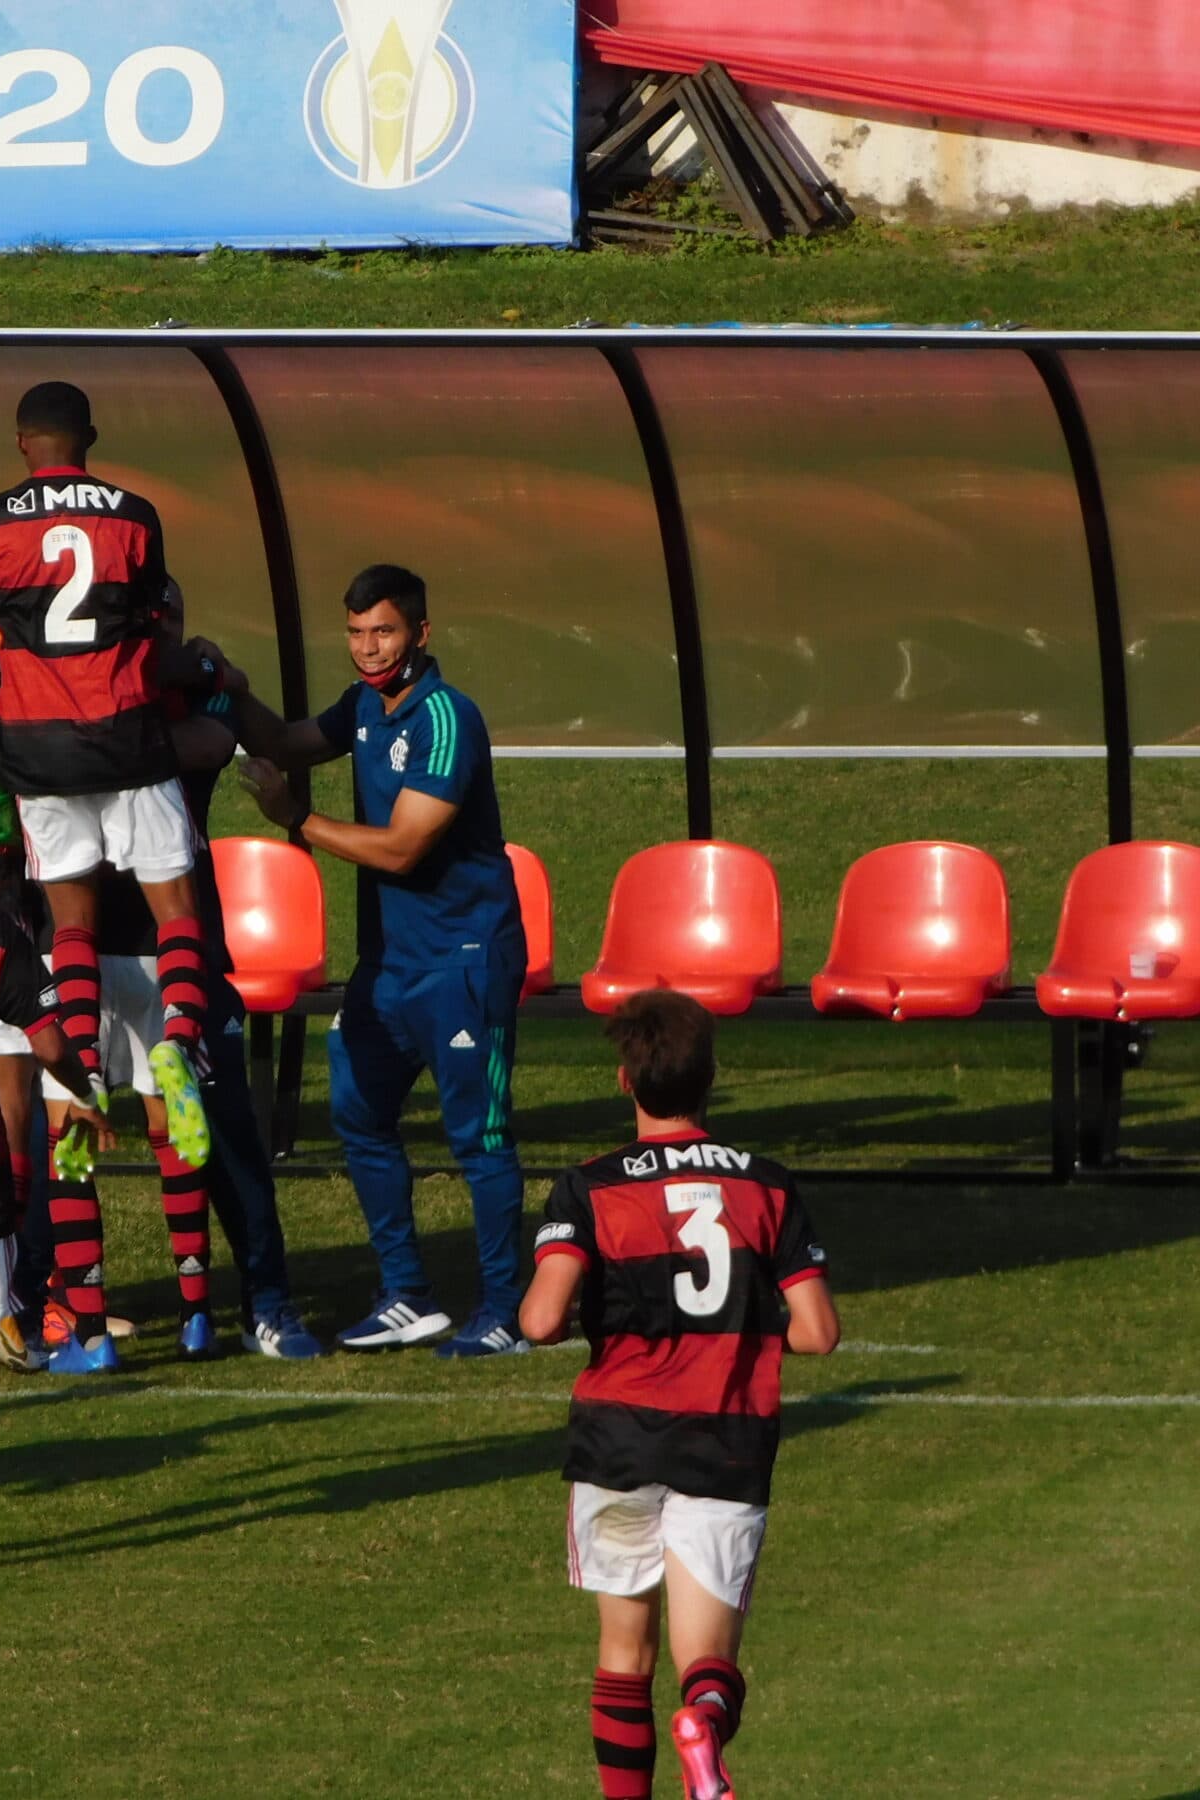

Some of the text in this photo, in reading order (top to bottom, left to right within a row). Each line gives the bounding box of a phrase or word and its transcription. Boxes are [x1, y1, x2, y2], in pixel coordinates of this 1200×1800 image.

[43, 484, 123, 511] MRV
[42, 524, 97, 643] 2
[664, 1143, 751, 1171] MRV
[664, 1182, 731, 1316] 3
